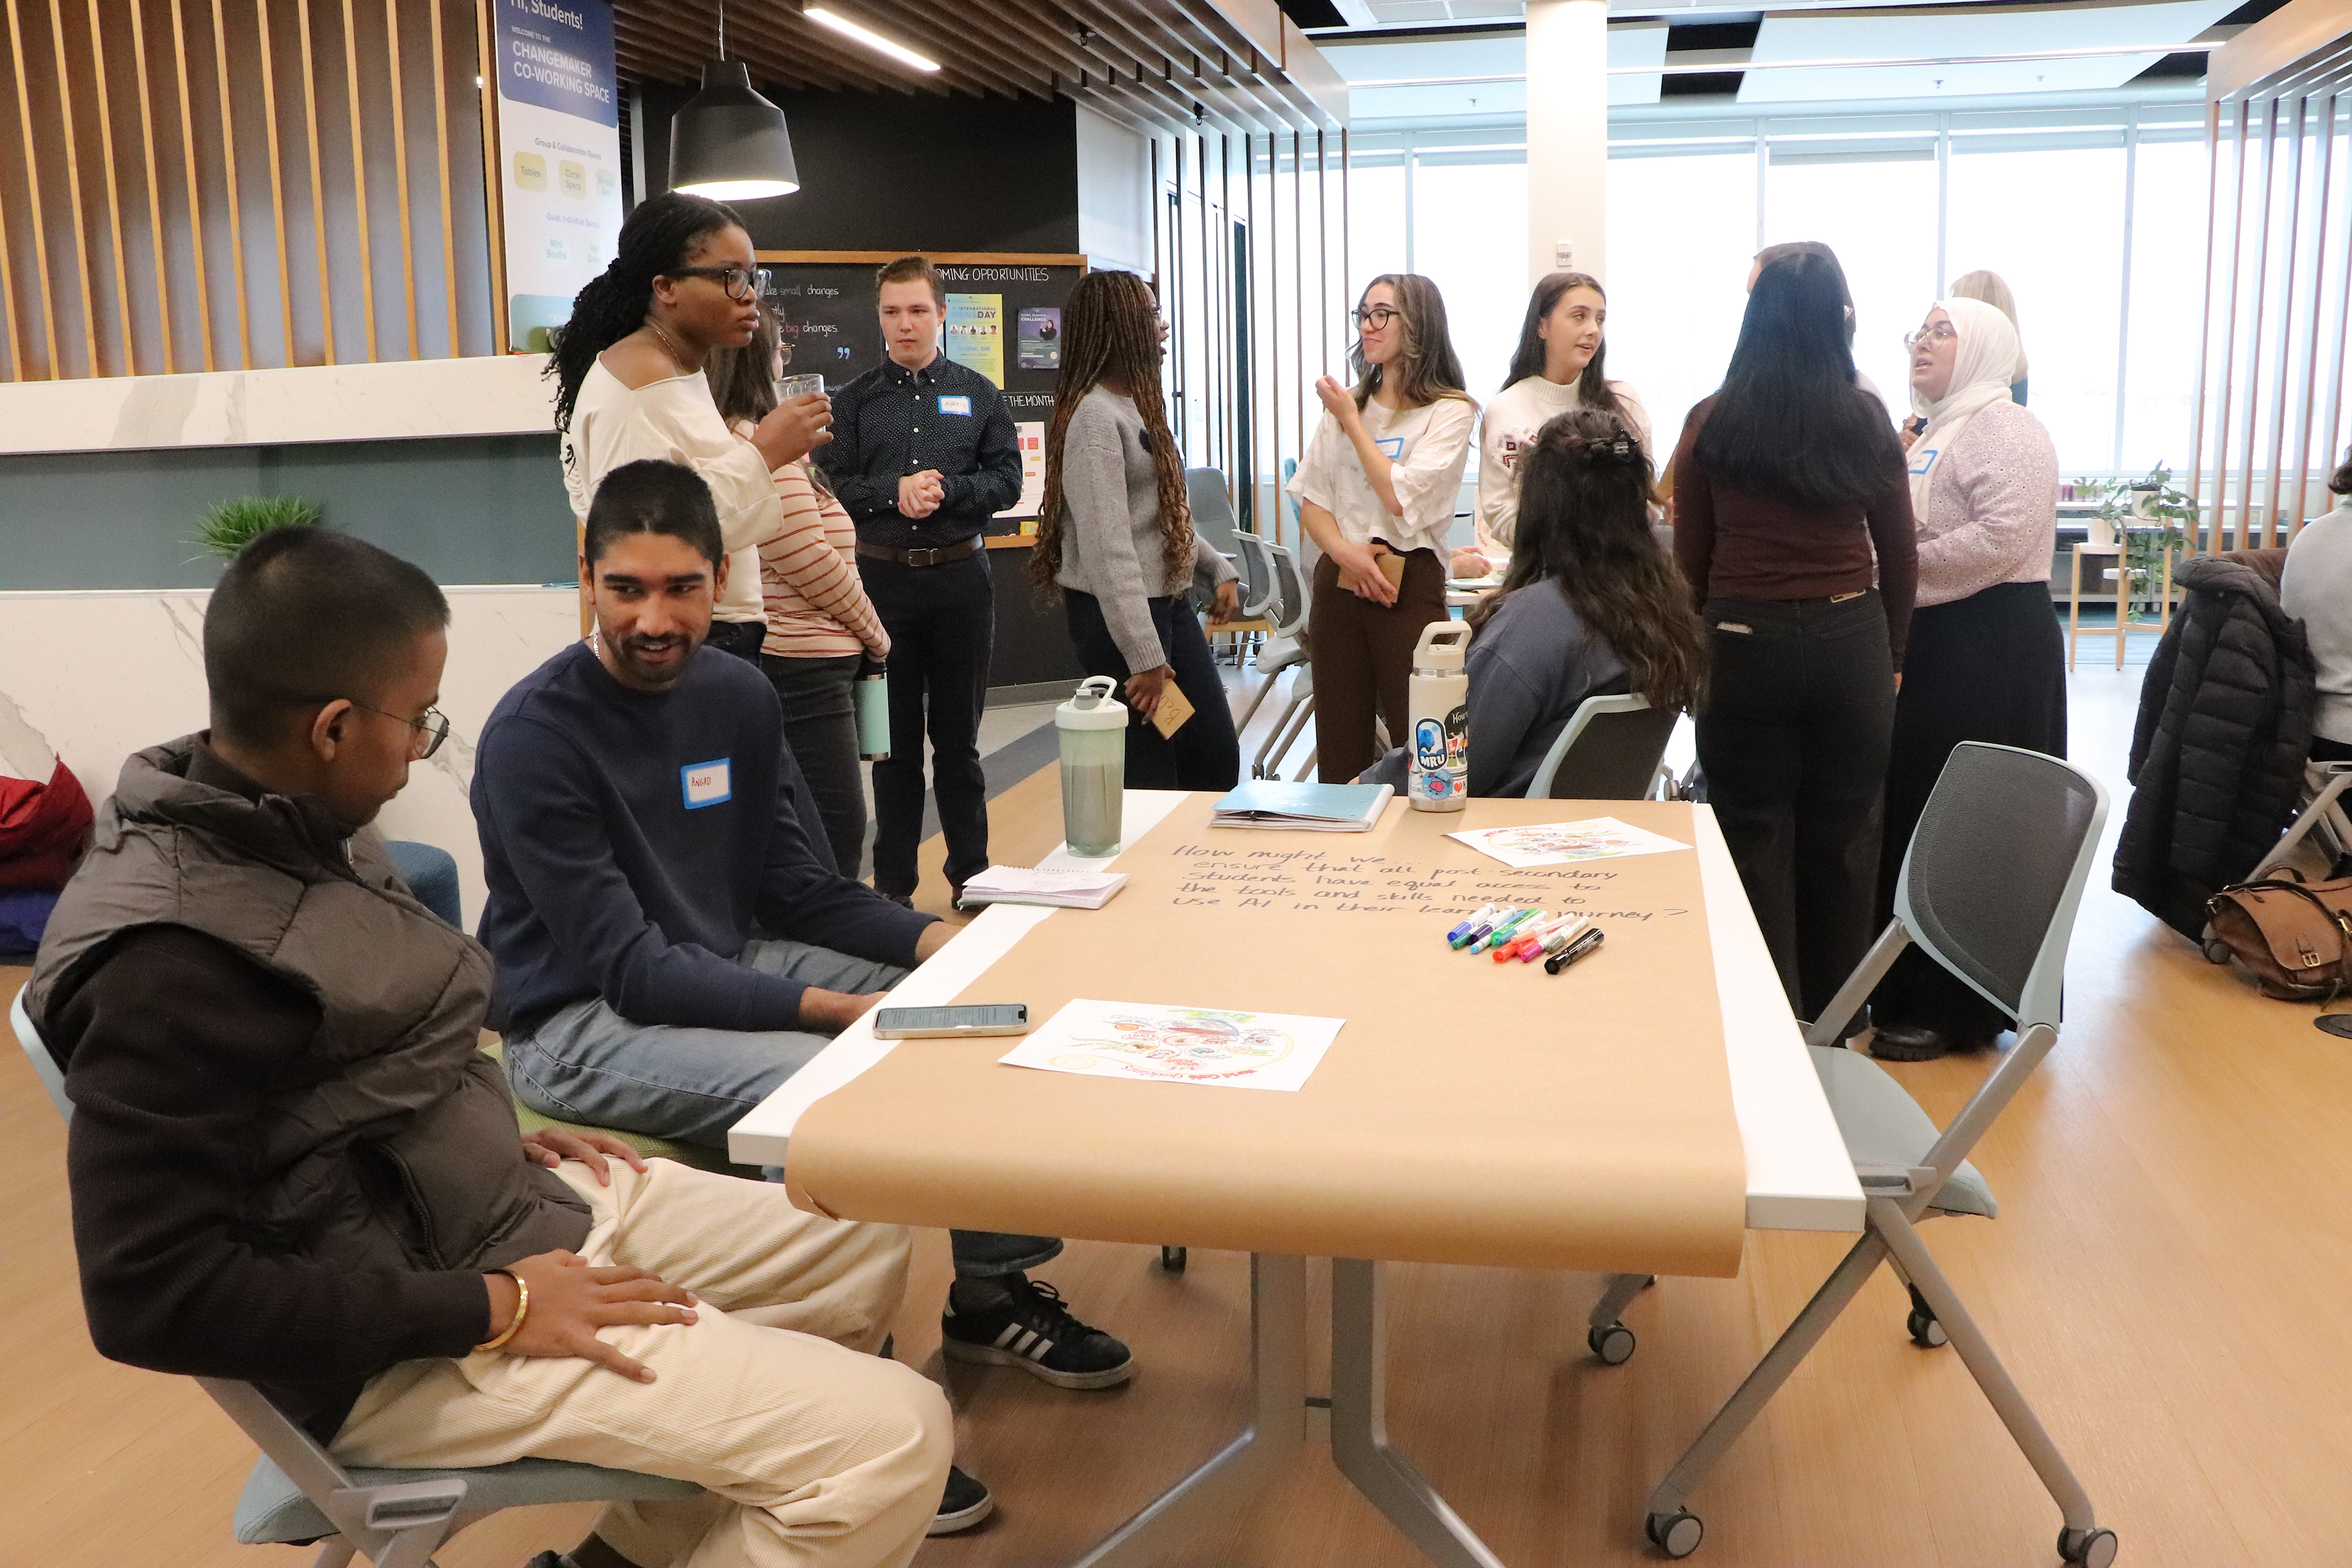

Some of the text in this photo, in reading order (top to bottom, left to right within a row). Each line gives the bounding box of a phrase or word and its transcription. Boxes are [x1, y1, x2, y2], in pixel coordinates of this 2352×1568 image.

[531, 0, 583, 30] Students!
[511, 26, 535, 39] WELCOME
[541, 34, 551, 43] THE
[513, 40, 592, 78] CHANGEMAKER
[514, 61, 609, 104] CO-WORKING SPACE
[535, 138, 551, 149] Group
[552, 141, 556, 149] &
[557, 142, 587, 157] Collaboration
[521, 166, 541, 178] Tables
[565, 168, 580, 180] Circle
[546, 213, 562, 223] Quiet,
[550, 239, 562, 249] Mini
[546, 249, 567, 260] Booths
[972, 268, 1049, 281] OPPORTUNITIES
[780, 285, 801, 296] small
[807, 284, 839, 298] changes
[803, 320, 838, 337] changes
[1008, 396, 1025, 407] THE
[1025, 396, 1055, 407] MONTH
[1420, 754, 1445, 768] MRU
[692, 777, 710, 786] ANGAD
[1172, 845, 1235, 856] How
[1247, 850, 1327, 865] might
[1193, 861, 1282, 870] ensure
[1300, 862, 1365, 873] that
[1316, 875, 1373, 886] have
[1386, 880, 1457, 891] equal
[1176, 883, 1217, 894] the
[1233, 885, 1296, 896] tools
[1313, 890, 1361, 899] and
[1376, 892, 1433, 901] skills
[1451, 894, 1548, 905] needed
[1237, 897, 1272, 908] AI
[1335, 902, 1406, 912] their
